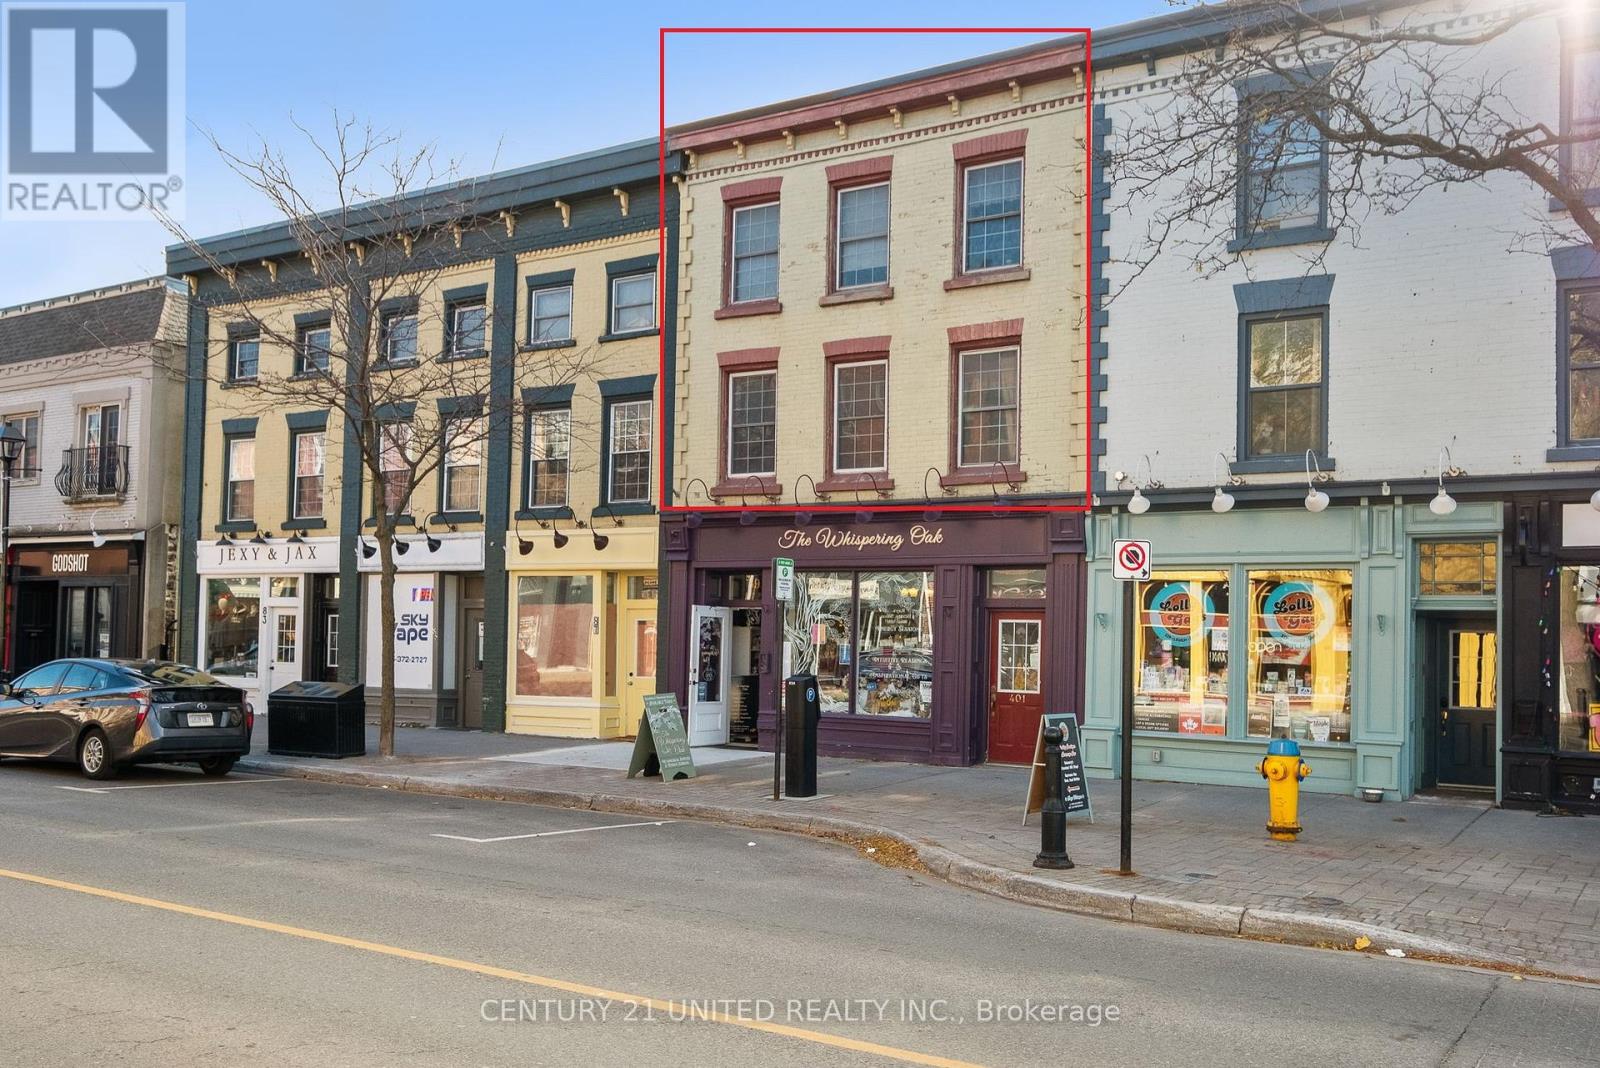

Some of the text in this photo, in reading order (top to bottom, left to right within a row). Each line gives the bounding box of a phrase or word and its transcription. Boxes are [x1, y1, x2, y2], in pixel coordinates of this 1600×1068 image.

[778, 525, 943, 551] The Whispering Oak
[52, 553, 89, 572] GODSHOT
[218, 546, 317, 565] JEXY & JAX
[1273, 598, 1314, 614] Lolly
[400, 613, 429, 626] SKY
[395, 623, 429, 645] ape
[1009, 694, 1026, 703] 401
